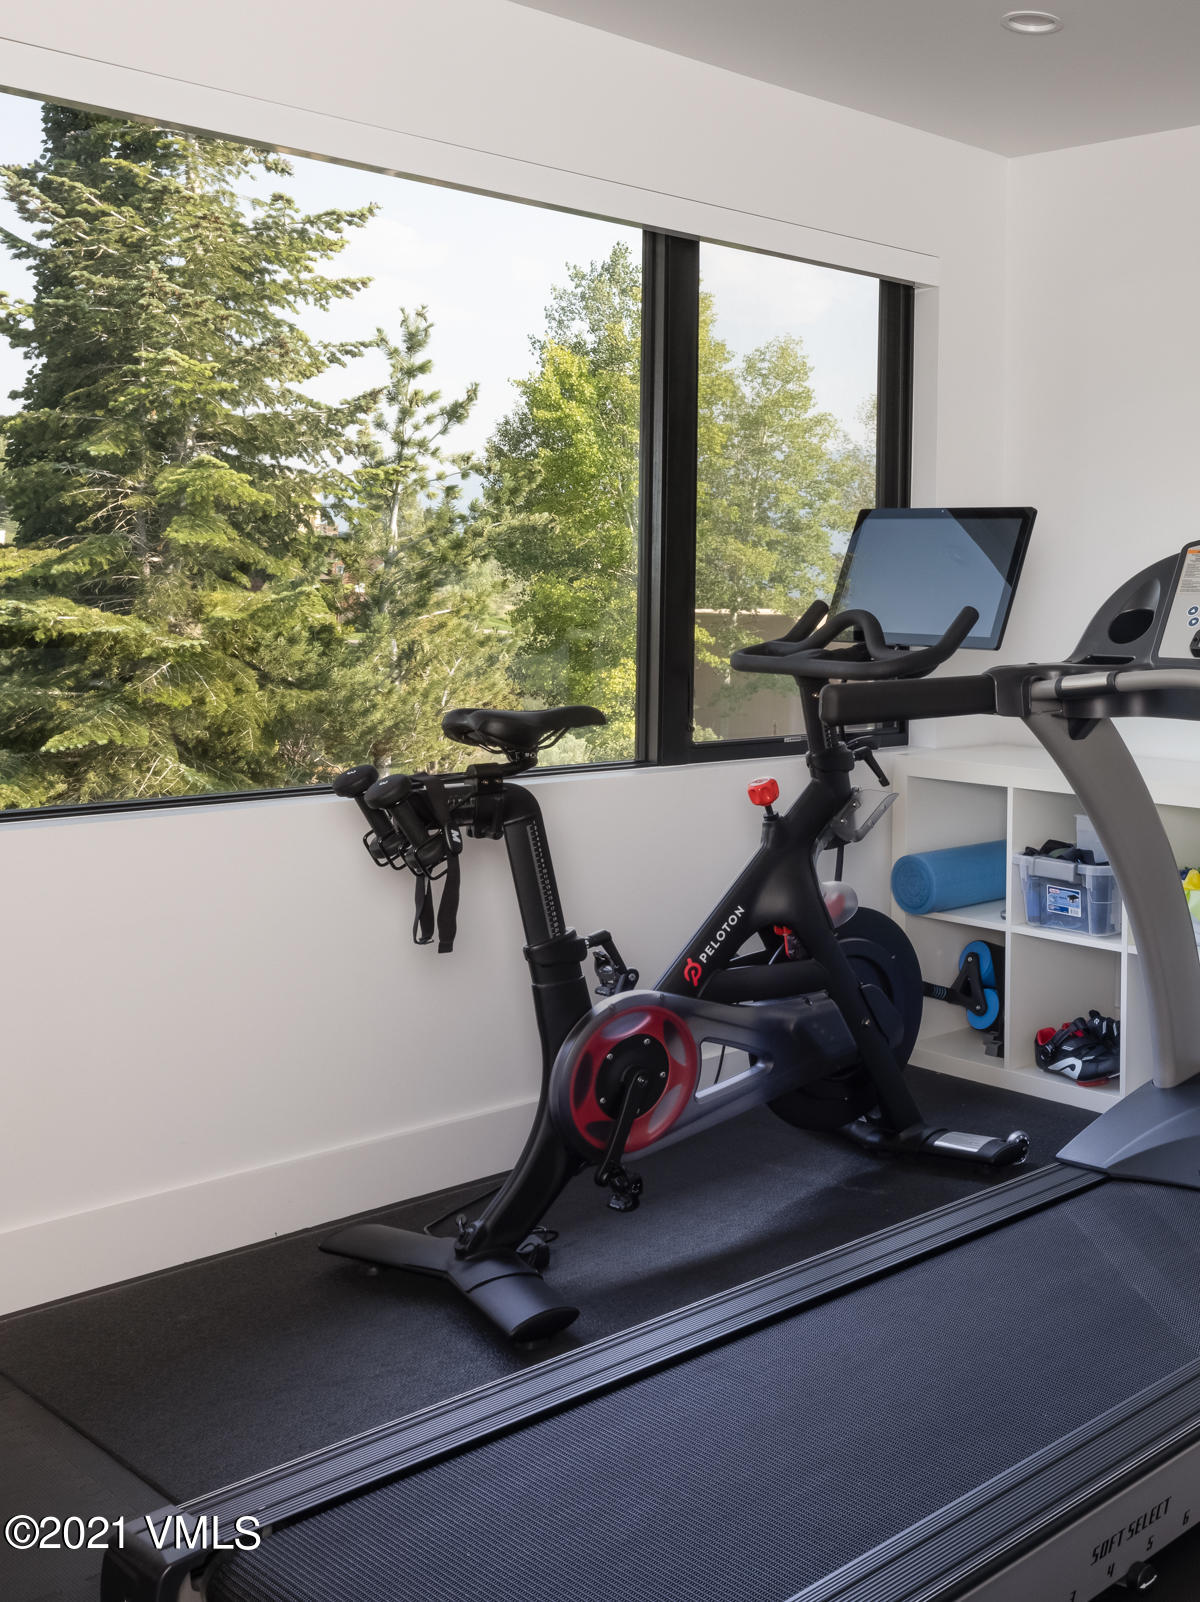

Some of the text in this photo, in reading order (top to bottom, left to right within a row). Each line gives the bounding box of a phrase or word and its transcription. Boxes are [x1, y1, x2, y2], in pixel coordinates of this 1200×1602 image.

[699, 905, 745, 964] PELOTON
[1182, 1509, 1191, 1526] 6
[1091, 1496, 1172, 1565] SOFT SELECT
[1146, 1534, 1155, 1551] 5
[1107, 1562, 1115, 1577] 4
